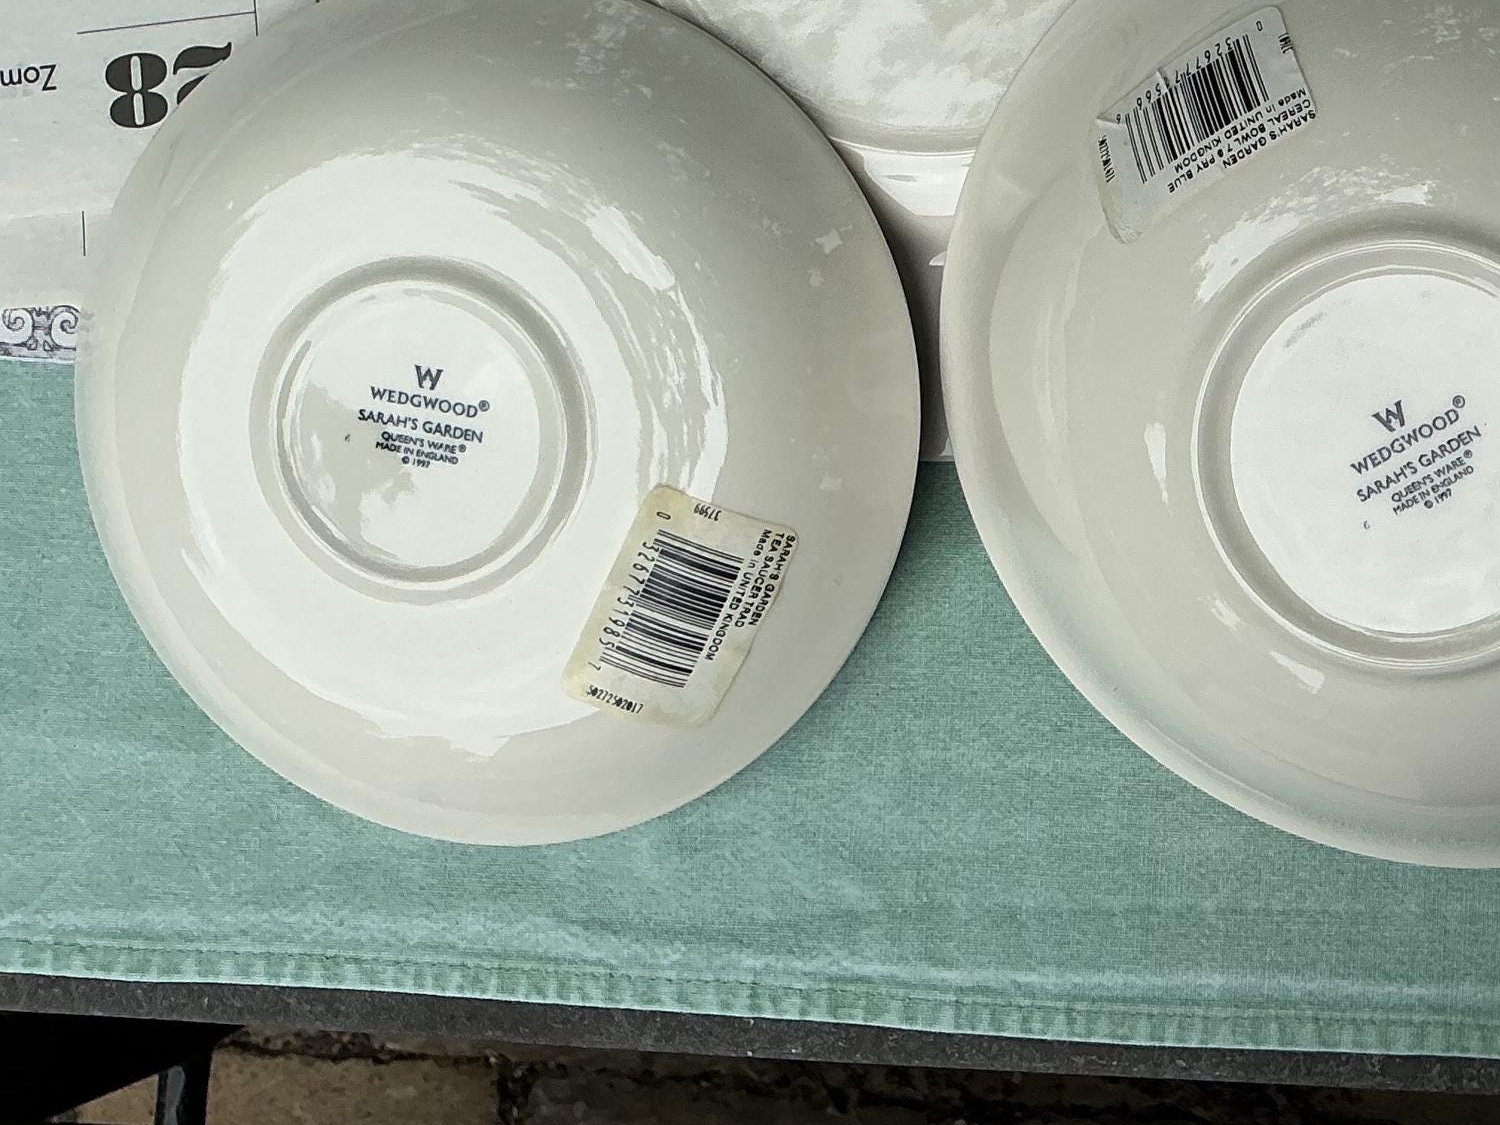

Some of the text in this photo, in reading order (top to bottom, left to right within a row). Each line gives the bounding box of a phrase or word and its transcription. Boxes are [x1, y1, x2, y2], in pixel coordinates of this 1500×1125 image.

[1266, 98, 1311, 126] CEREAL
[1174, 87, 1307, 174] Made in UNITED KINGDOM
[1222, 109, 1317, 169] SARAH'S GARDEN
[1233, 122, 1267, 146] BOWL
[1196, 153, 1216, 174] PRY
[1167, 169, 1194, 194] BLUE
[357, 408, 484, 444] SARAH'S GARDEN
[380, 430, 425, 448] QUEEN'S
[375, 441, 459, 465] MADE IN ENGLAND
[412, 458, 431, 468] 1997
[1356, 425, 1482, 503] SARAH'S GARDEN
[1390, 473, 1435, 503] QUEEN'S
[1392, 465, 1474, 516] MADE IN ENGLAND
[656, 511, 672, 521] 0
[704, 529, 773, 661] Made in UNITED KINGDOM
[734, 532, 785, 628] TEA SAUCER TRAD
[748, 534, 796, 626] SARAH'S GARDEN
